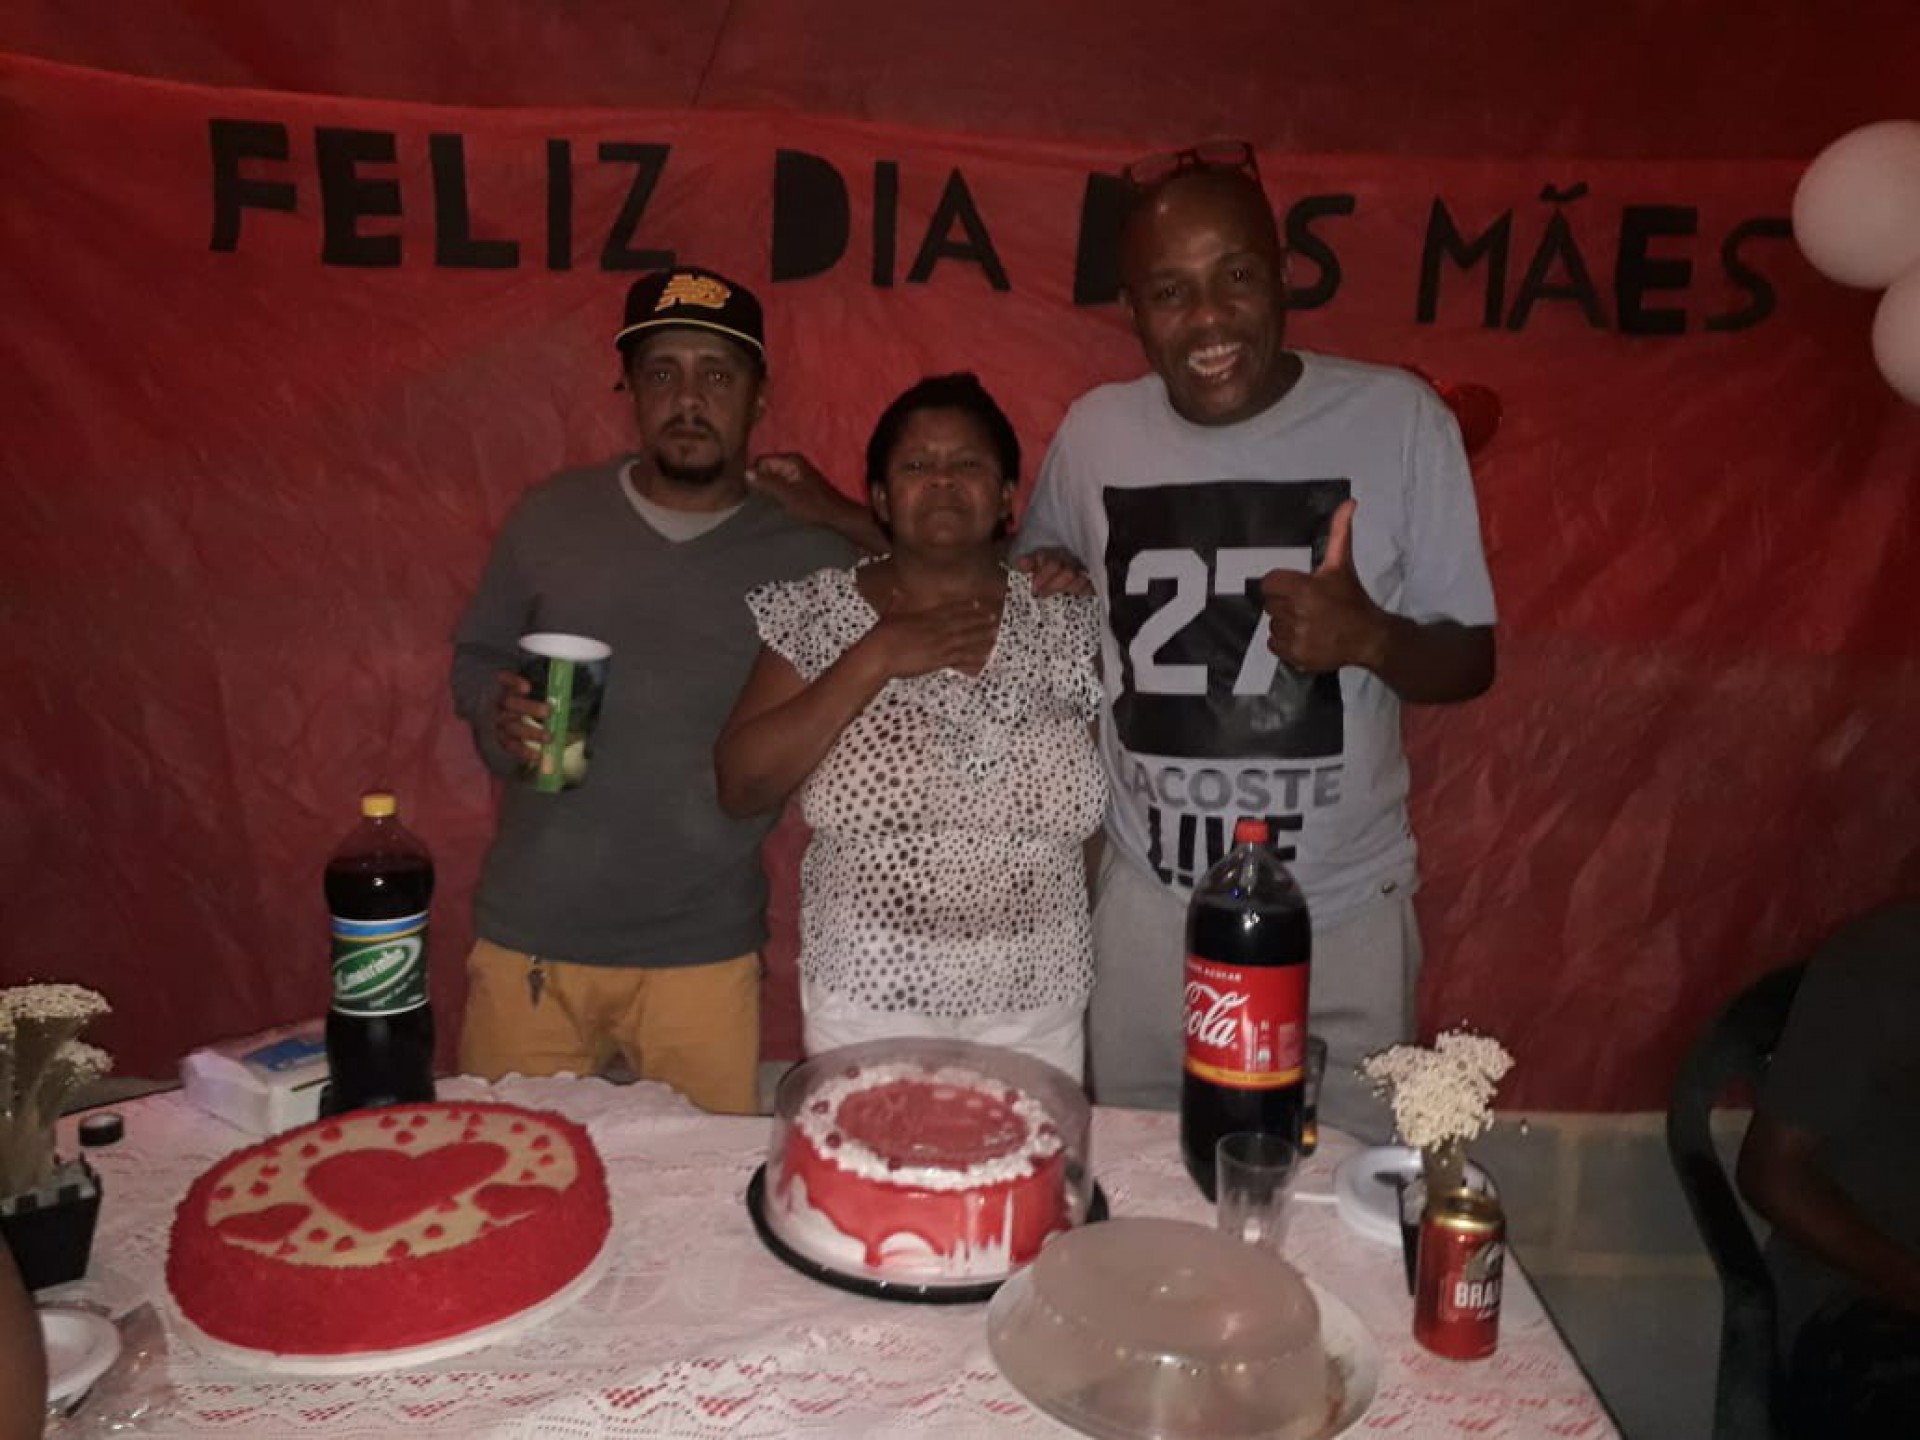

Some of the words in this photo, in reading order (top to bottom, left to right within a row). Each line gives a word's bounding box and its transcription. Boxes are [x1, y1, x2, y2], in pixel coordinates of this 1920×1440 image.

[208, 118, 676, 271] FELIZ
[771, 148, 1012, 291] DIA
[1073, 171, 1356, 310] DS
[1416, 182, 1794, 336] MÃES
[1124, 546, 1313, 695] 27
[1117, 754, 1344, 811] LACOSTE
